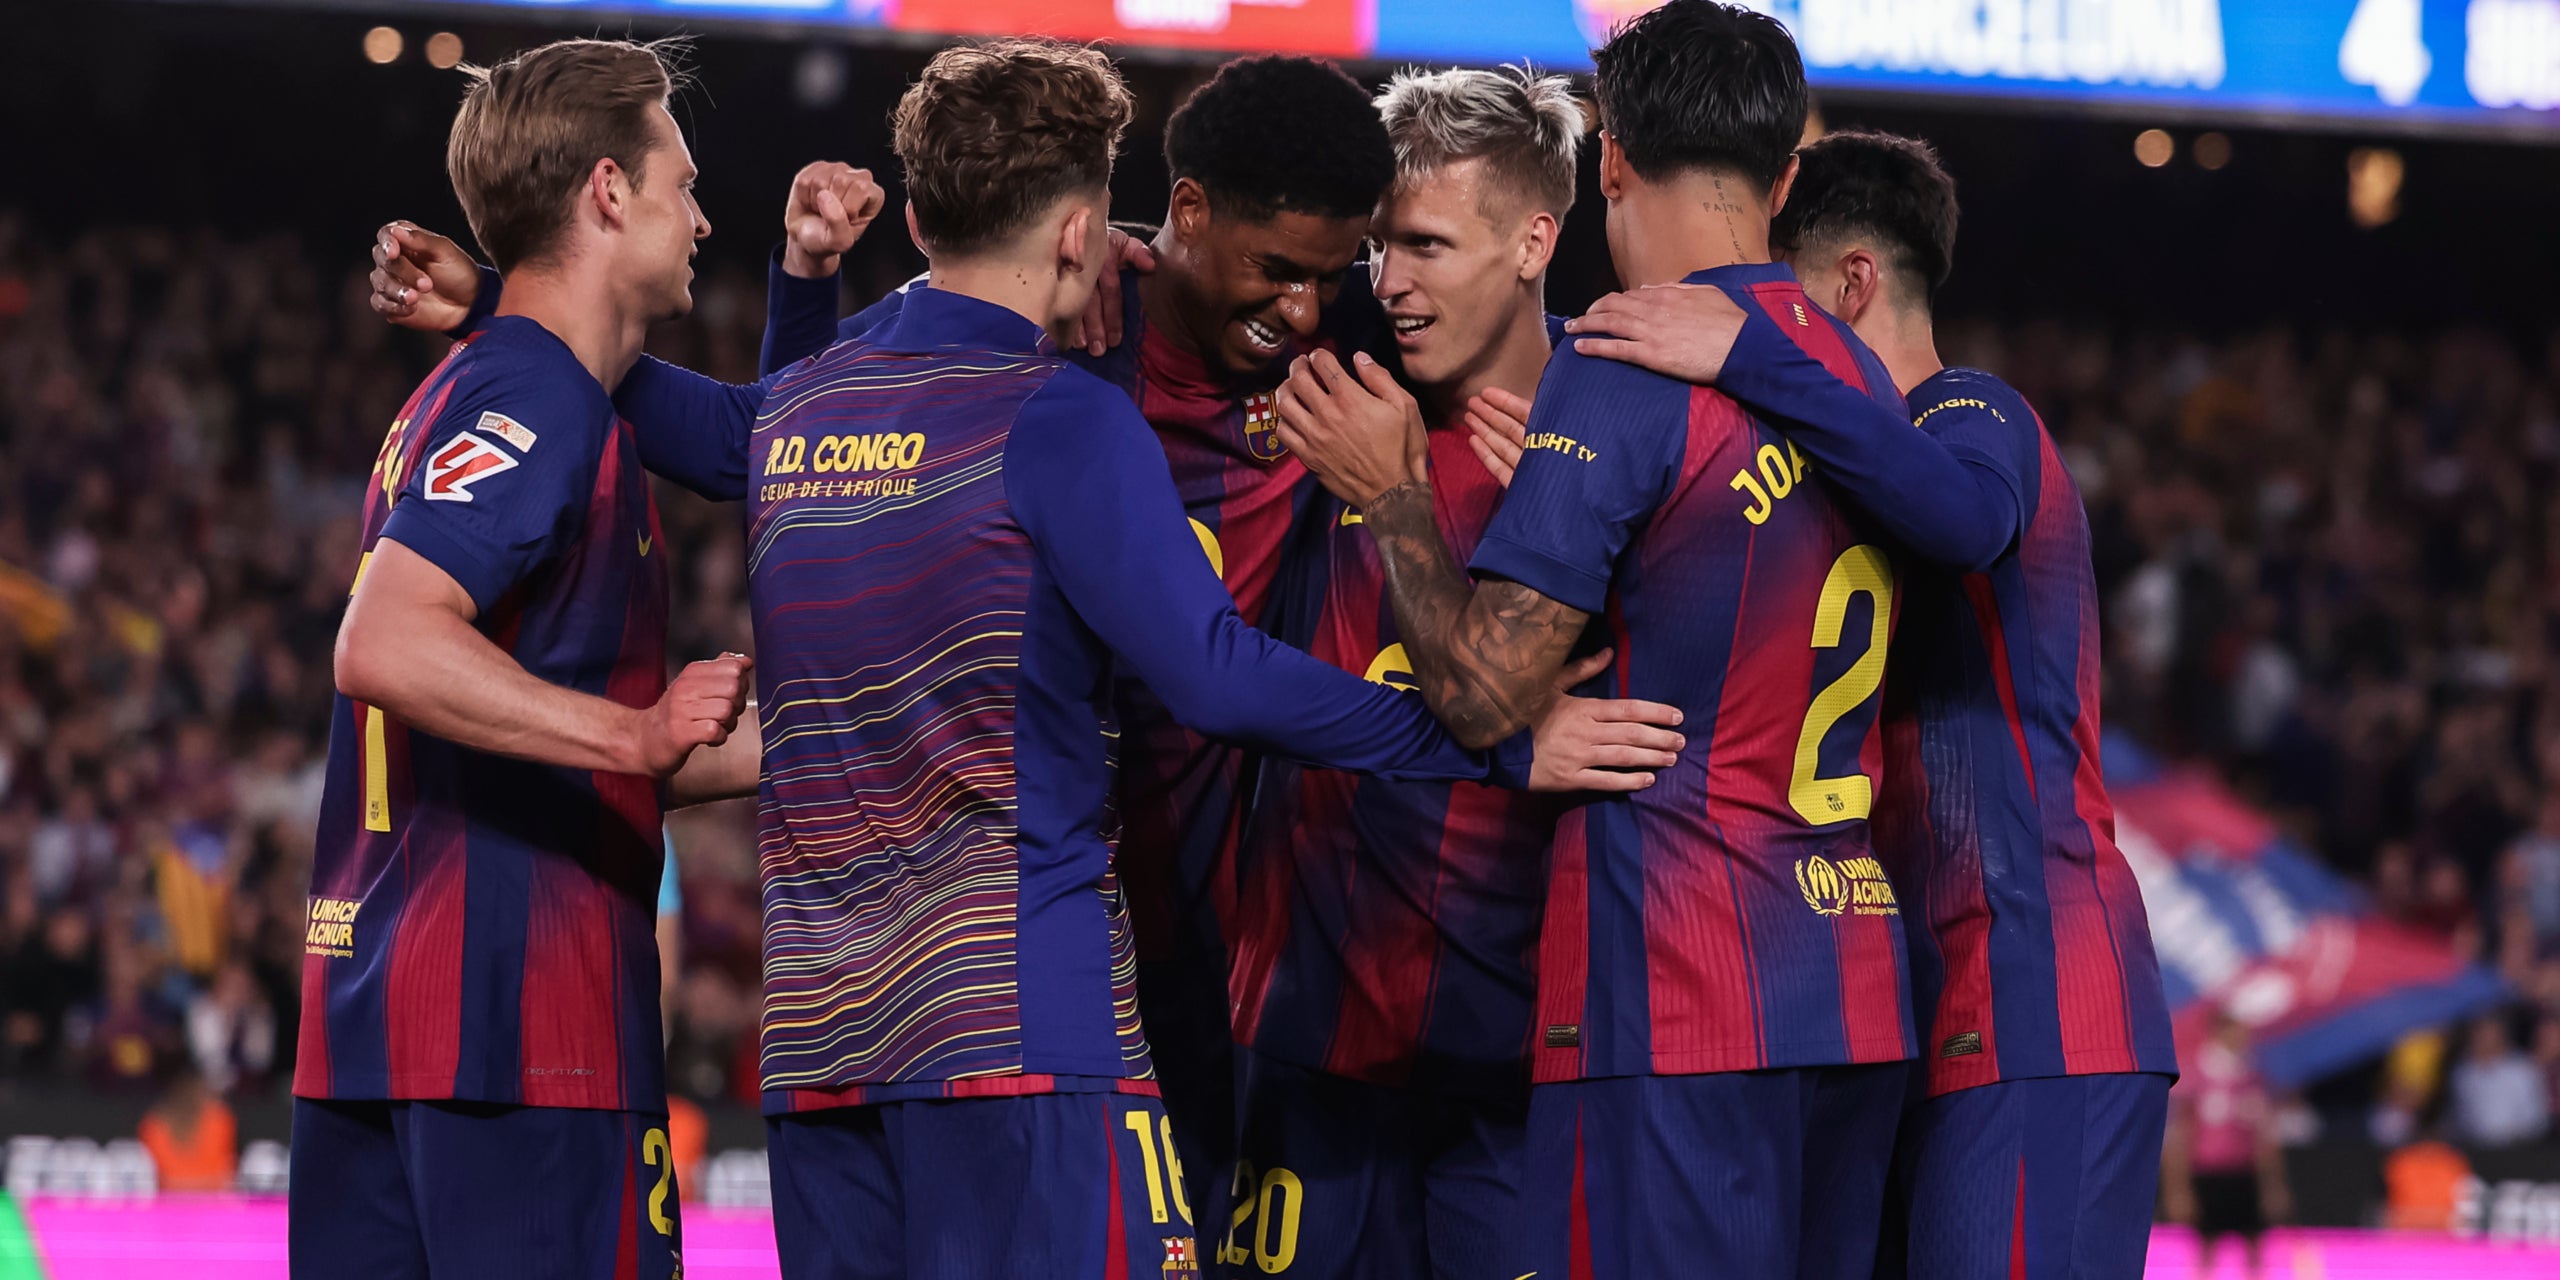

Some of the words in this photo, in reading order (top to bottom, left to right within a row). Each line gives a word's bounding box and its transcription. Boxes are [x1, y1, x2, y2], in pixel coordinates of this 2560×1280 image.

[763, 436, 806, 476] R.D.
[813, 432, 926, 473] CONGO
[1577, 445, 1597, 462] tv
[799, 481, 822, 498] DE
[1788, 544, 1893, 826] 2
[1852, 880, 1896, 904] ACNUR
[311, 898, 362, 922] UNHCR
[306, 921, 353, 946] ACNUR
[1216, 1159, 1303, 1274] 20
